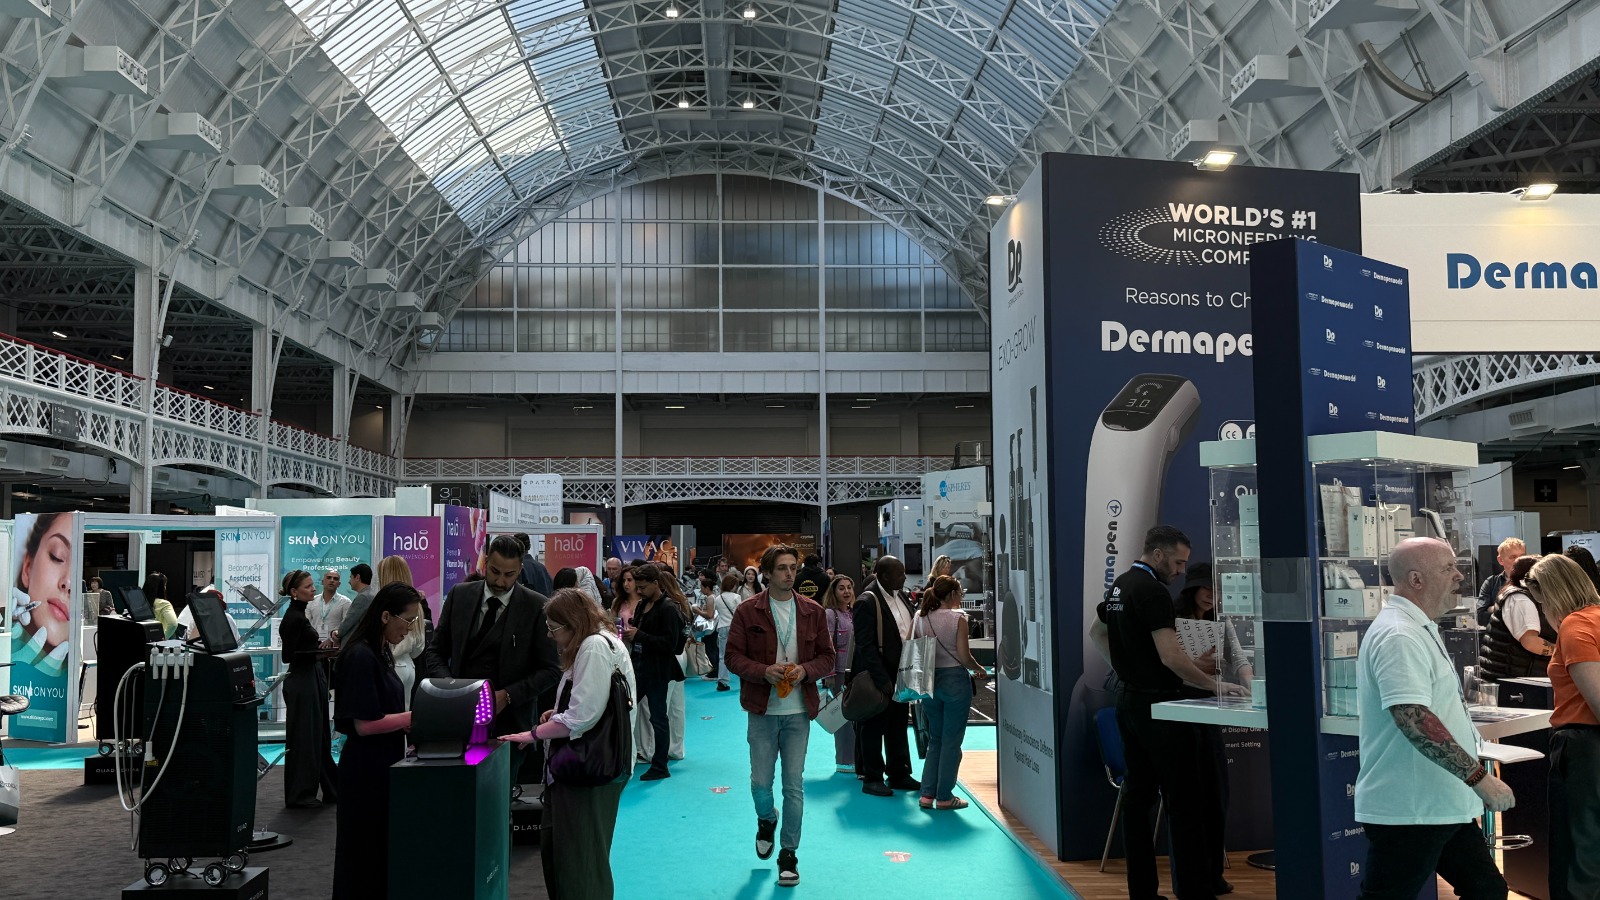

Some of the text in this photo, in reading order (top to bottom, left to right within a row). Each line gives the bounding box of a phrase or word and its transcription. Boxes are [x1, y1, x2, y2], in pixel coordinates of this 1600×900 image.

[1291, 210, 1316, 230] #1
[1173, 228, 1318, 245] MICRONEED
[1446, 252, 1598, 290] Derma
[1126, 287, 1200, 307] Reasons
[1206, 291, 1224, 307] to
[241, 532, 253, 541] ON
[254, 530, 271, 540] YOU
[288, 534, 366, 546] SKIN ON YOU
[335, 556, 360, 564] Beauty
[228, 564, 251, 572] Become
[229, 574, 262, 582] Aesthetics
[1337, 597, 1349, 606] Dp
[34, 686, 46, 698] ON
[47, 687, 65, 699] YOU
[1240, 741, 1261, 749] Setting
